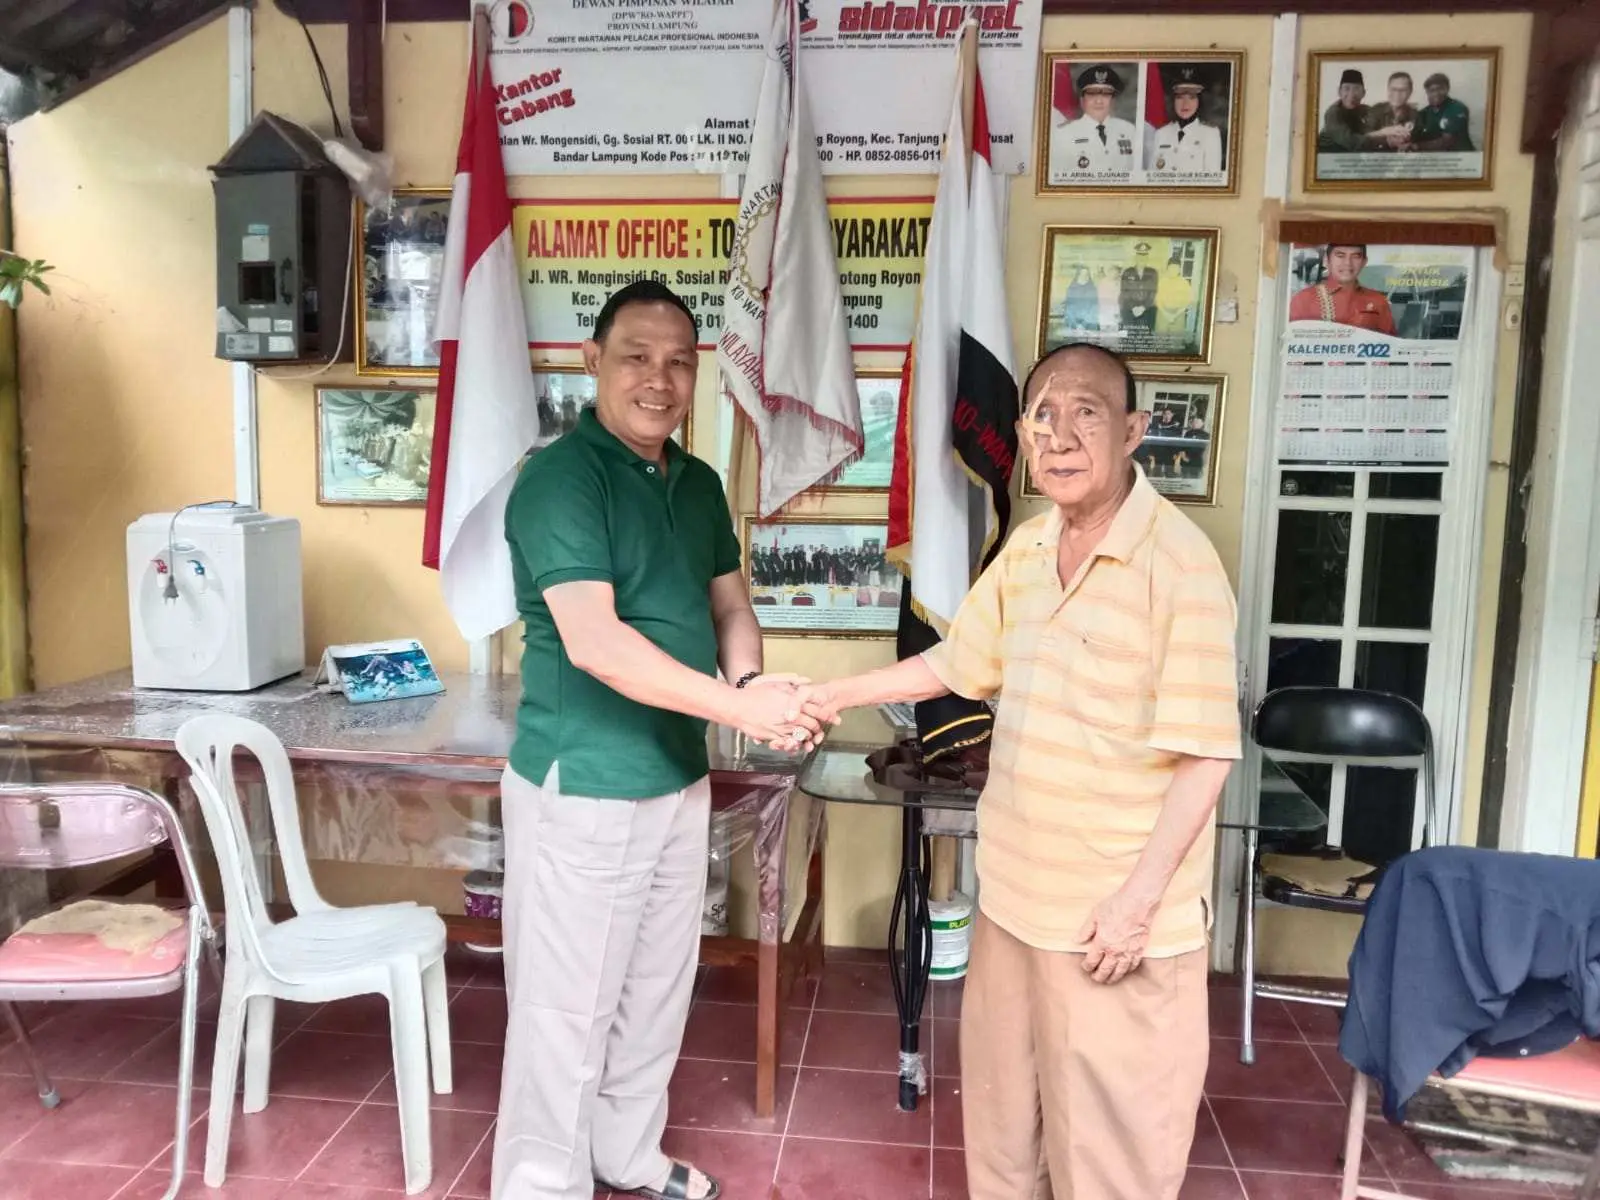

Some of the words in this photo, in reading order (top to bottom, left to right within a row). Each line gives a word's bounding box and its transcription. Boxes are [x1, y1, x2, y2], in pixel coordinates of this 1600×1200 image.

[572, 0, 615, 8] DEWAN
[717, 32, 760, 40] INDONESIA
[495, 68, 562, 104] Kantor
[497, 88, 576, 126] Cabang
[704, 118, 750, 129] Alamat
[522, 134, 537, 146] Wr.
[540, 134, 601, 148] Mongensidi,
[603, 134, 621, 147] Gg.
[623, 133, 655, 145] Sosial
[657, 133, 673, 145] RT.
[697, 133, 715, 144] LK.
[728, 133, 747, 144] NO.
[826, 133, 868, 147] Royong,
[871, 133, 895, 145] Kec.
[897, 133, 940, 147] Tanjung
[988, 133, 1014, 144] usat
[553, 151, 590, 162] Bandar
[592, 151, 638, 164] Lampung
[640, 150, 667, 162] Kode
[669, 150, 688, 161] Pos
[846, 150, 862, 161] HP.
[865, 150, 941, 161] 0852-0856-011
[527, 218, 610, 258] ALAMAT
[616, 218, 689, 258] OFFICE
[708, 217, 736, 258] TO
[829, 217, 932, 258] YARAKAT
[528, 270, 544, 284] Jl.
[548, 270, 573, 284] WR.
[577, 270, 647, 287] Monginsidi
[675, 271, 714, 284] Sosial
[839, 270, 877, 288] otong
[881, 270, 921, 288] Royon
[572, 292, 600, 305] Kec.
[846, 314, 878, 328] 1400
[1287, 344, 1356, 355] KALENDER
[1357, 343, 1391, 358] 2022
